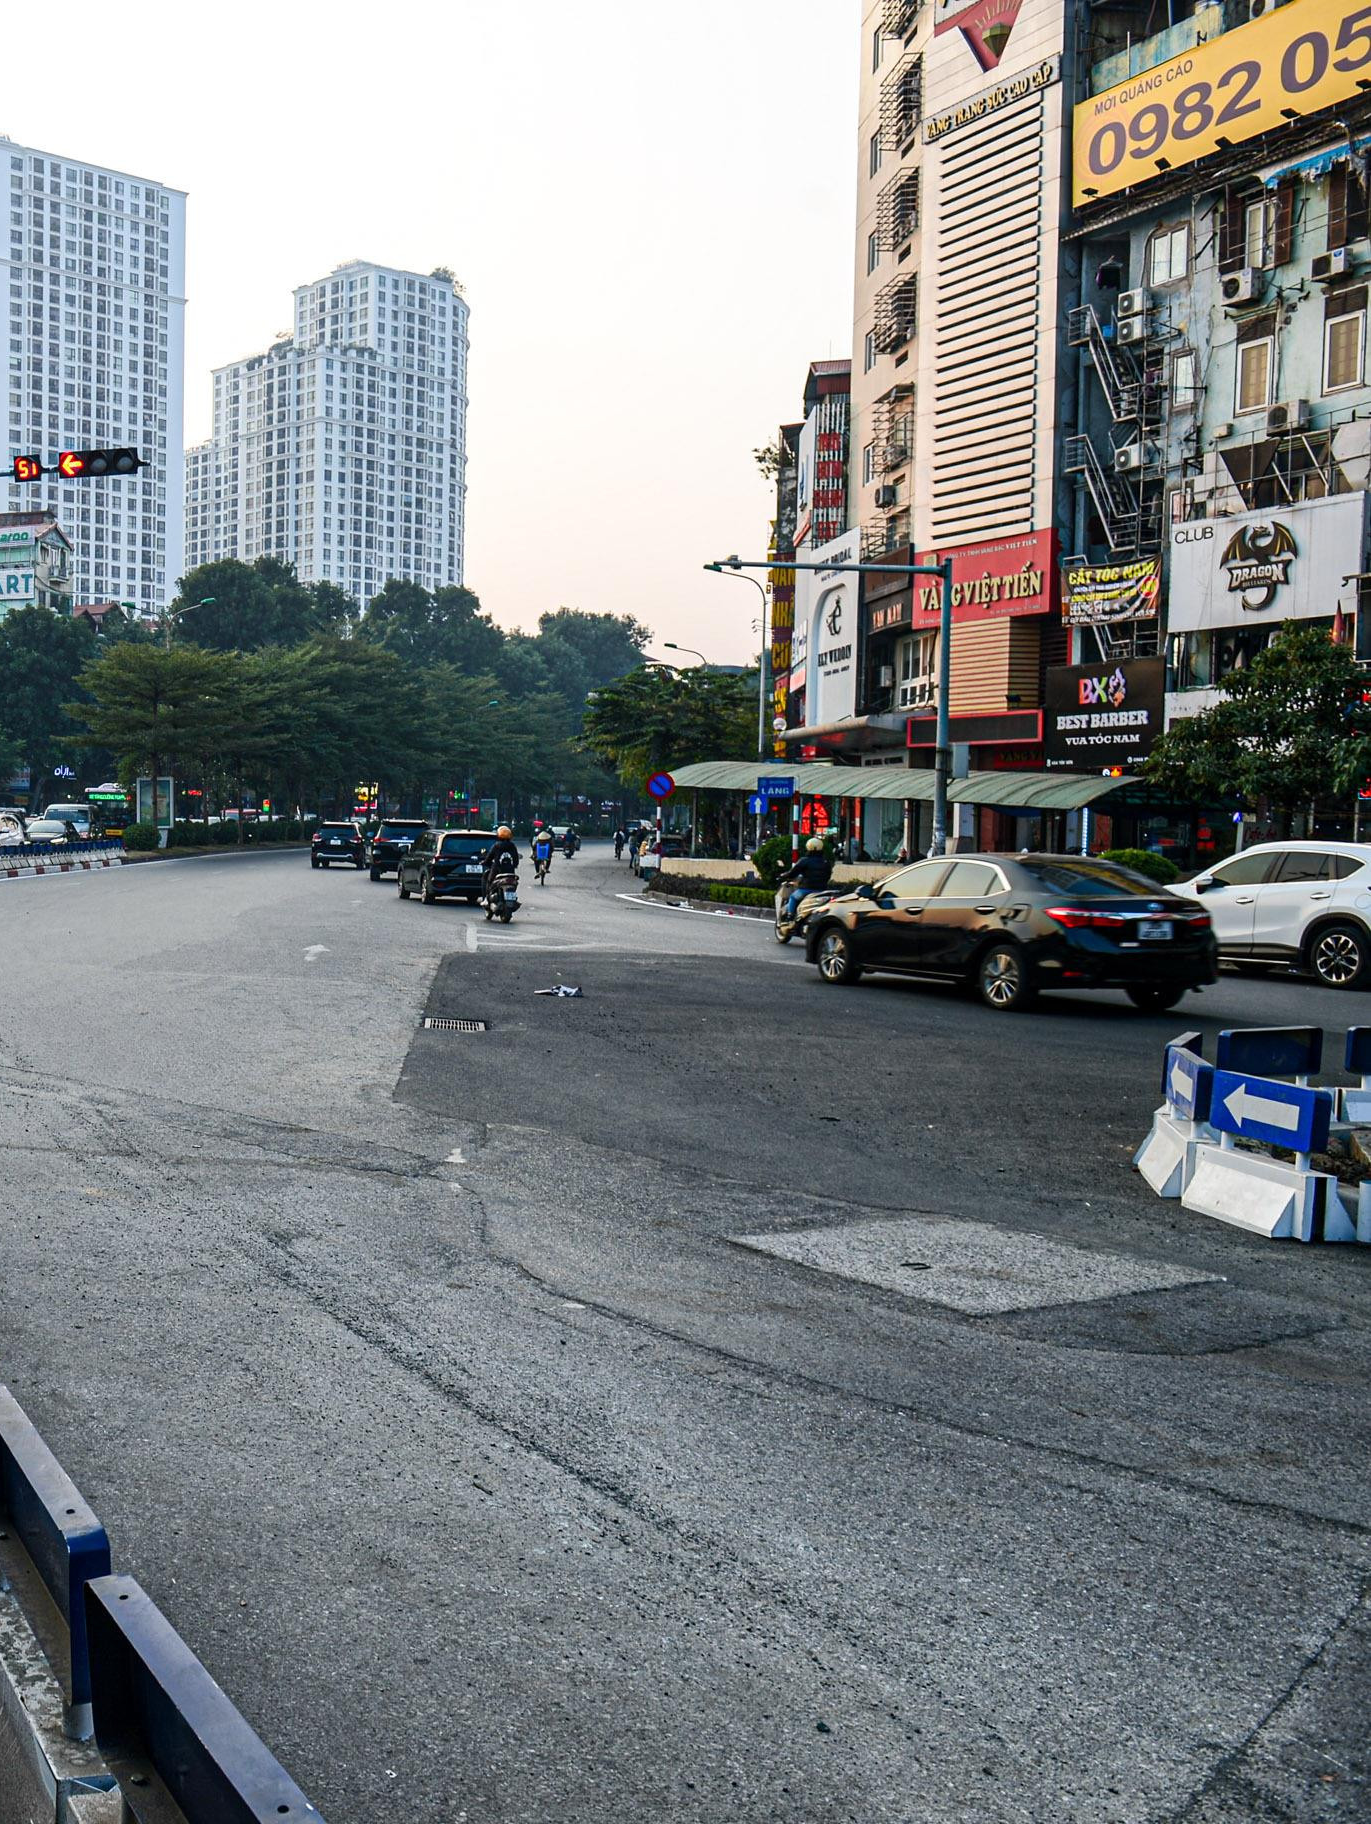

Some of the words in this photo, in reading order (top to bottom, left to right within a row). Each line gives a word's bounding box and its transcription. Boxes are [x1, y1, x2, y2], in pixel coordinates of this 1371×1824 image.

[953, 98, 985, 127] TRANG
[1009, 77, 1029, 99] CAO
[1088, 60, 1262, 176] 0982
[1280, 7, 1371, 94] 05
[1094, 95, 1117, 116] MỜI
[1119, 73, 1163, 104] QUẢNG
[21, 462, 37, 477] 51
[1174, 526, 1214, 545] CLUB
[1122, 561, 1155, 580] NAM
[1230, 562, 1285, 587] DRAGON
[919, 580, 963, 611] VÀG
[963, 571, 1002, 610] VIỆT
[1003, 560, 1044, 600] TIẾN
[1056, 714, 1089, 731] BEST
[1090, 710, 1149, 728] BARBER
[1065, 737, 1088, 746] VUA
[1088, 732, 1111, 745] TÓC
[1113, 734, 1140, 743] NAM
